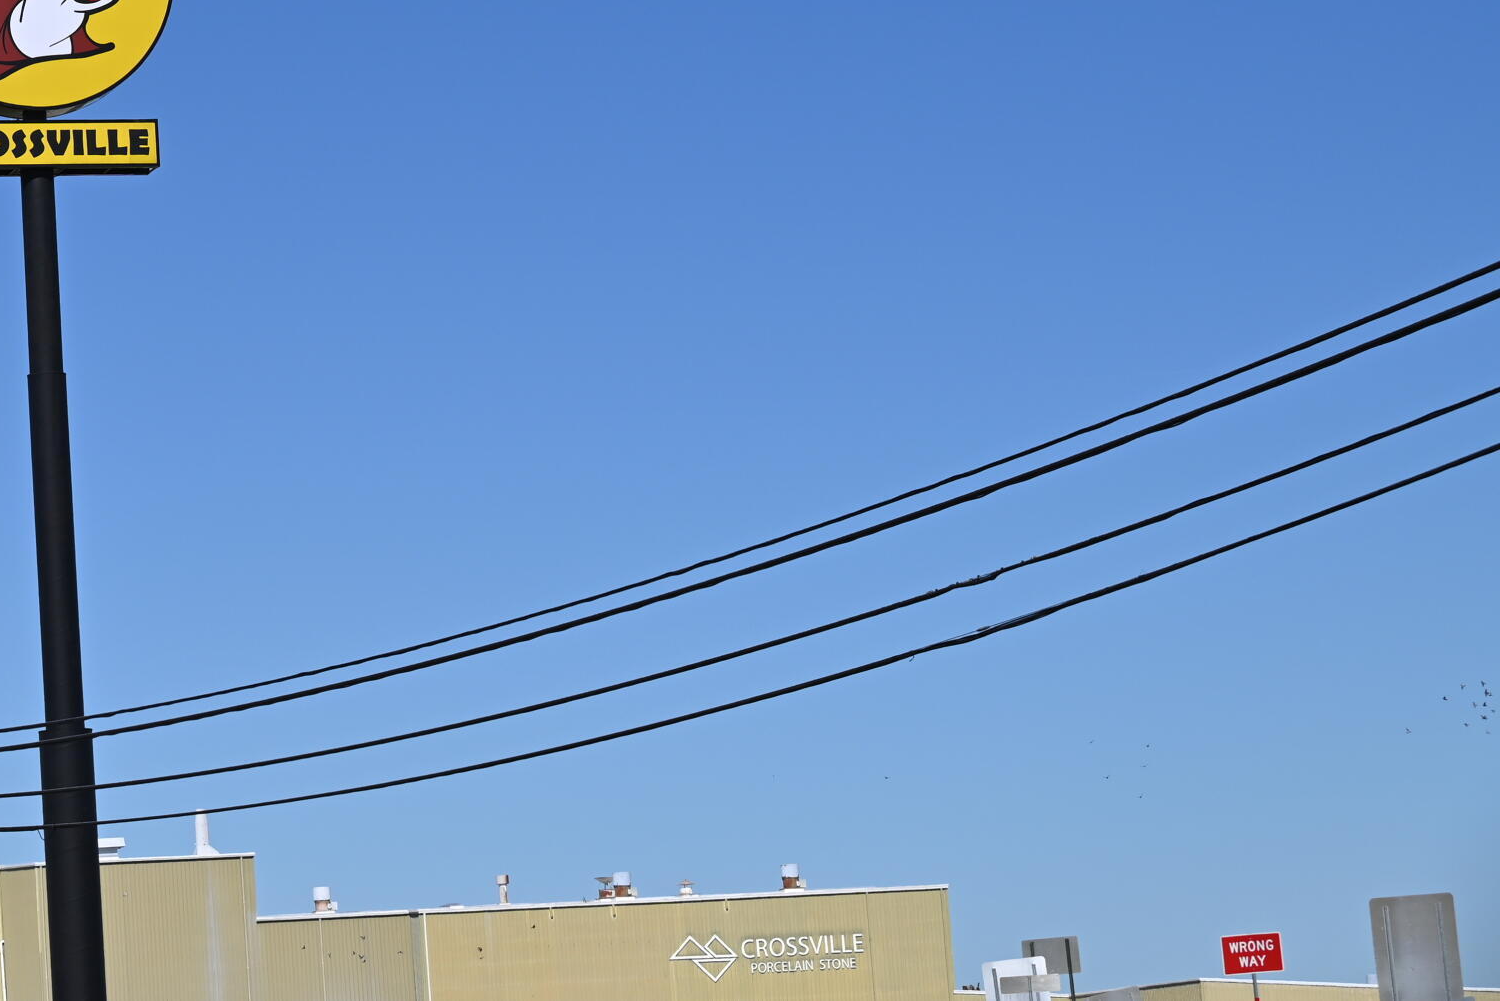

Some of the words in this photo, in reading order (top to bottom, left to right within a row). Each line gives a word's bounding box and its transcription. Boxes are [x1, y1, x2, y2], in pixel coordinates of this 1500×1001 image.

[740, 933, 865, 960] CROSSVILLE
[1228, 939, 1274, 954] WRONG
[751, 960, 815, 974] PORCELAIN
[819, 958, 857, 971] STONE
[1239, 955, 1266, 968] WAY
